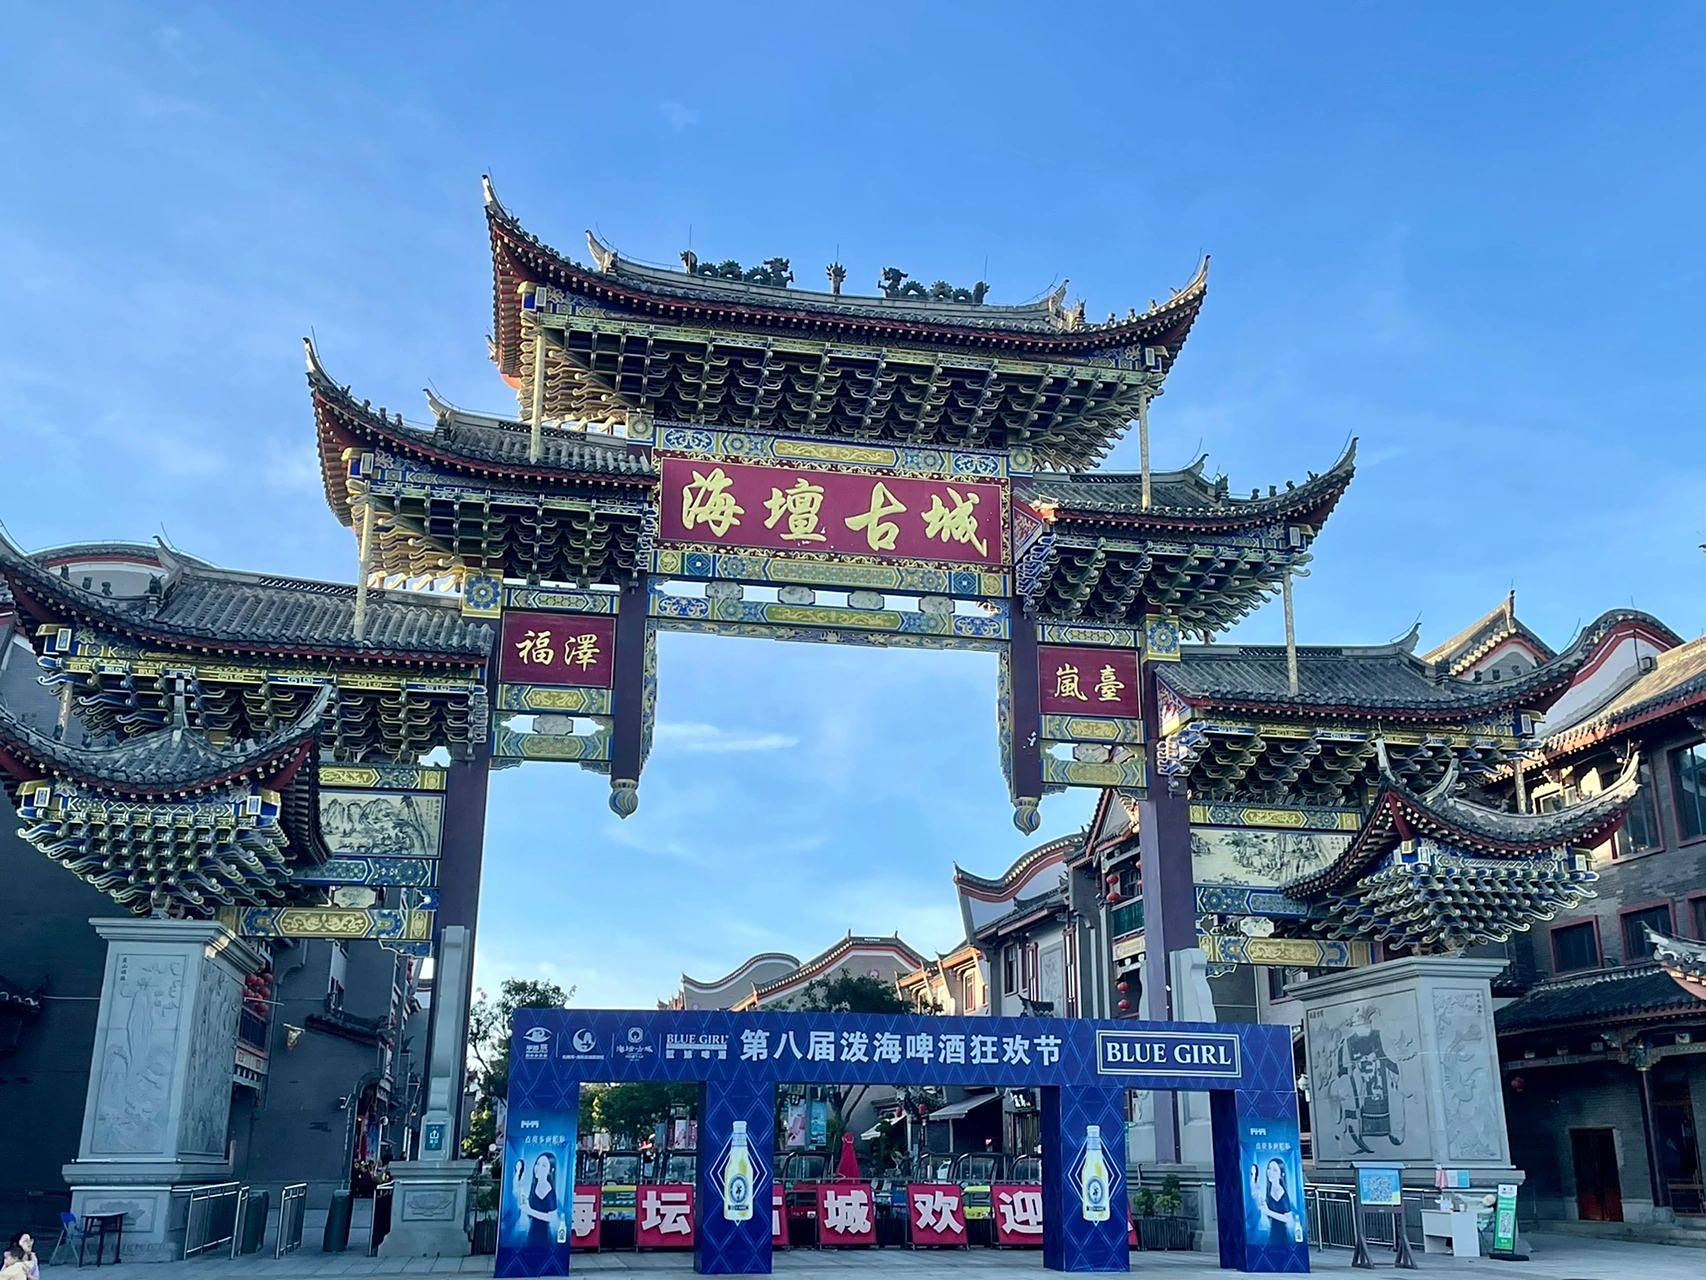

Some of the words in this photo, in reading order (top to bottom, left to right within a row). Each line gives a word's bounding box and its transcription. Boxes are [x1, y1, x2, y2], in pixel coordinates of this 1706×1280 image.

[682, 467, 988, 558] 海壇古城
[515, 630, 600, 672] 福澤
[1054, 663, 1125, 702] 嵐臺
[666, 1033, 696, 1044] BLUE
[698, 1034, 728, 1045] GIRL
[740, 1029, 1062, 1066] 第八届泼海啤酒狂欢节
[1106, 1042, 1167, 1063] BLUE
[1173, 1044, 1232, 1065] GIRL
[642, 1190, 692, 1235] 坛
[823, 1190, 872, 1234] 城
[913, 1190, 964, 1234] 欢
[998, 1190, 1043, 1234] 迎
